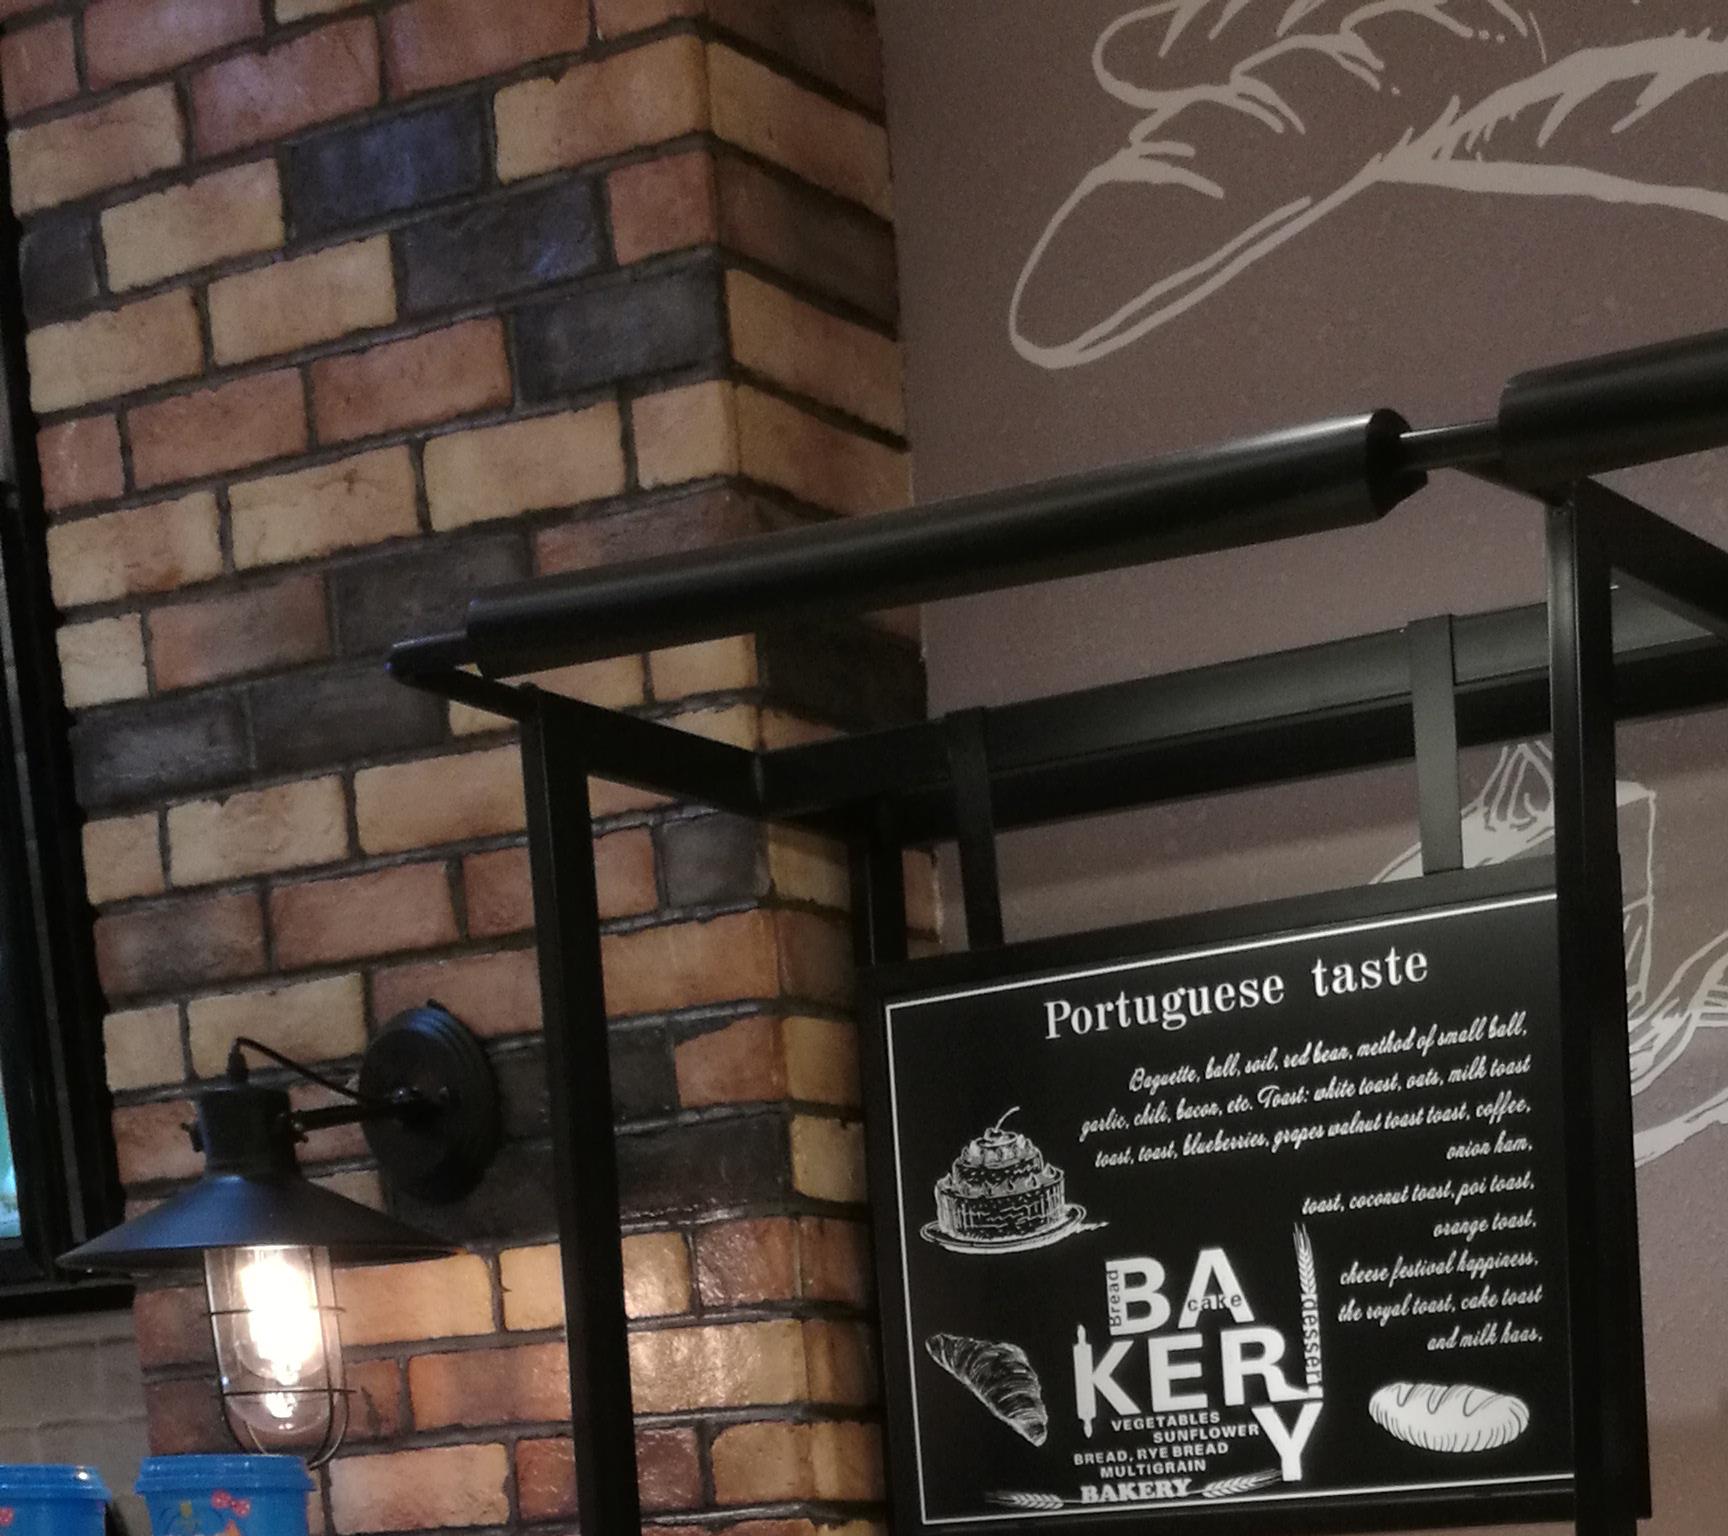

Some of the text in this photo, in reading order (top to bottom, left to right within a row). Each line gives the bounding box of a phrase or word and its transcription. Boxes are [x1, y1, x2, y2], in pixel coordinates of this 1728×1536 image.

[1044, 946, 1428, 1039] Portuguese taste
[1283, 1042, 1312, 1068] red
[1356, 1026, 1415, 1057] method
[1417, 1023, 1438, 1057] of
[1437, 1016, 1487, 1047] small
[1314, 1076, 1356, 1102] white
[1448, 1055, 1487, 1083] milk
[1490, 1054, 1531, 1077] toast
[1272, 1122, 1325, 1153] grapes
[1328, 1110, 1382, 1137] walnut
[1384, 1108, 1424, 1130] toast
[1446, 1140, 1491, 1160] onion
[1349, 1185, 1409, 1209] coconut
[1433, 1219, 1488, 1242] orange
[1340, 1261, 1389, 1285] cheese
[1389, 1250, 1457, 1288] festival
[1107, 1269, 1121, 1328] Bread
[1187, 1293, 1242, 1312] cake
[1338, 1299, 1363, 1322] the
[1366, 1293, 1412, 1327] royal
[1461, 1284, 1498, 1310] cake
[1501, 1285, 1542, 1305] toast
[1427, 1326, 1459, 1350] and
[1459, 1322, 1498, 1348] milk
[1111, 1411, 1220, 1431] VEGETABLES
[1153, 1423, 1259, 1443] SUNFLOWER
[1137, 1447, 1168, 1461] RYE
[1172, 1442, 1229, 1457] BREAD
[1100, 1459, 1206, 1479] MULTIGRAIN
[1080, 1478, 1192, 1504] BAKERY
